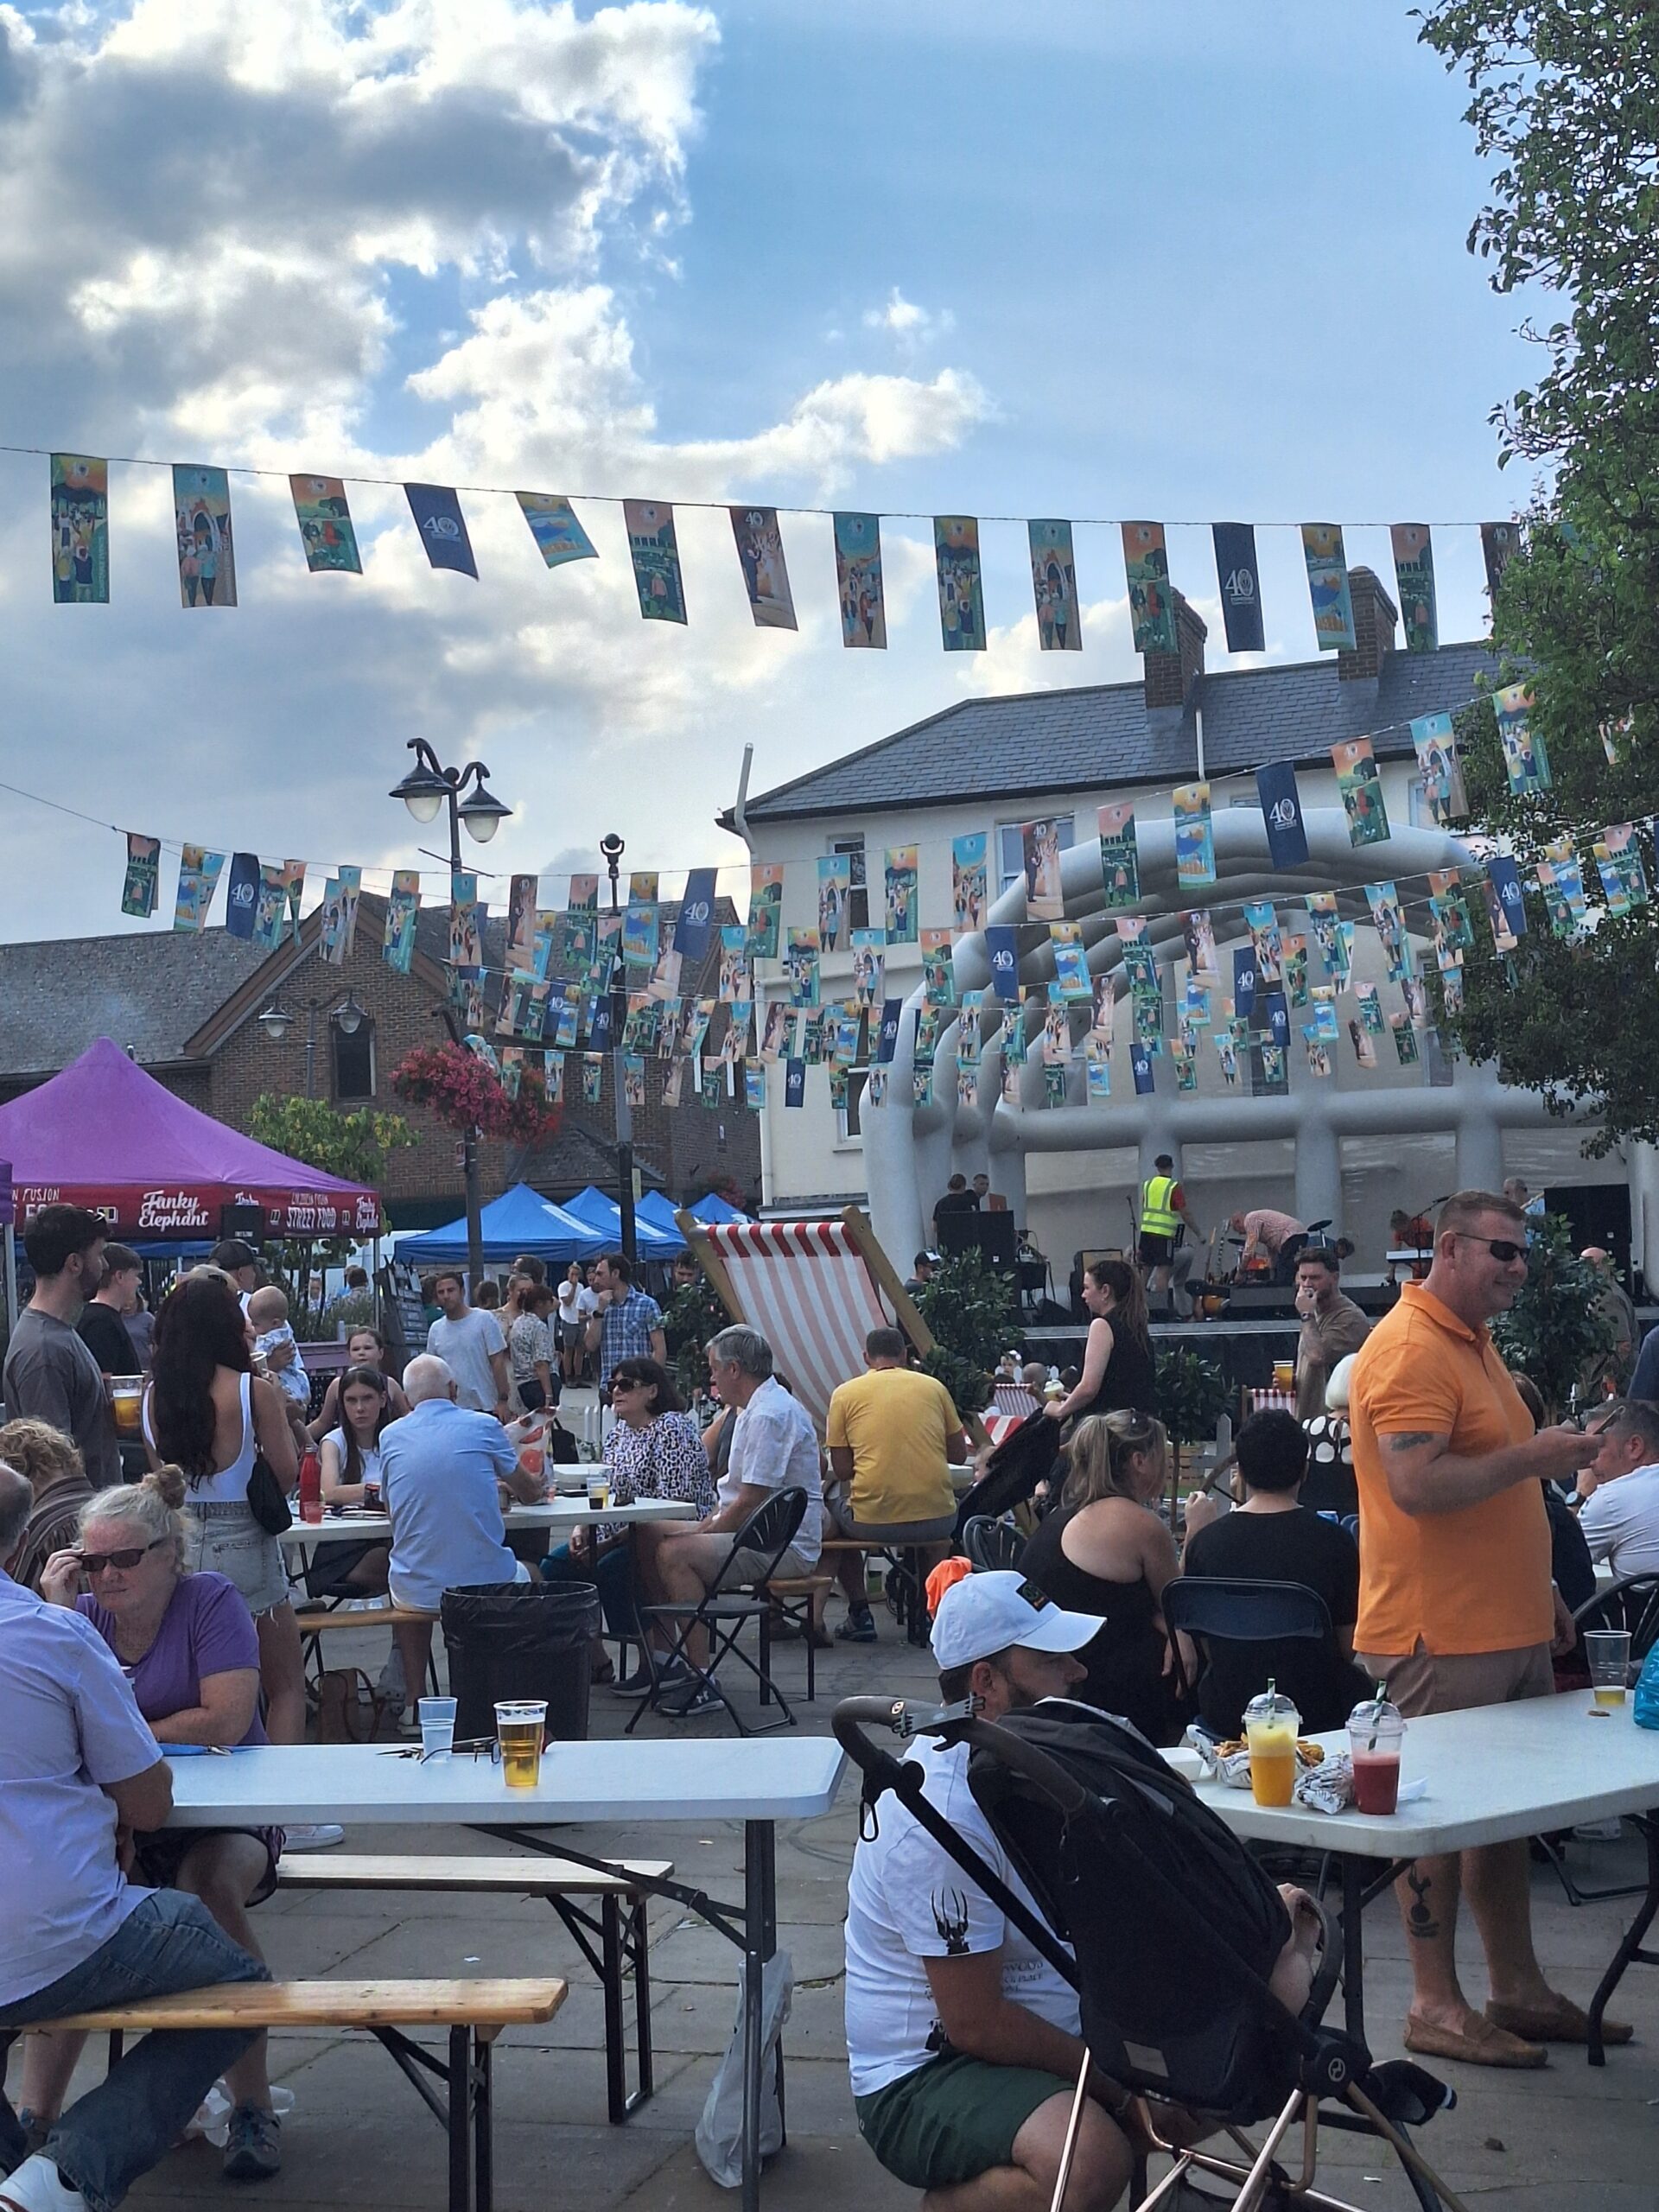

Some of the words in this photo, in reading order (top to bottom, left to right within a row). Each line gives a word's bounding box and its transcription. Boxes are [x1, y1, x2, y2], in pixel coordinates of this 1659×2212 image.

[423, 516, 460, 536] 40
[1224, 569, 1253, 596] 40
[1269, 798, 1295, 823] 40
[231, 883, 255, 904] 40
[1501, 881, 1520, 900] 40
[684, 901, 709, 922] 40
[993, 950, 1014, 967] 40
[1237, 970, 1254, 987] 40
[1134, 1059, 1148, 1072] 40
[22, 1187, 60, 1202] FUSION
[138, 1209, 209, 1232] Elephant
[286, 1206, 315, 1229] STREET
[316, 1207, 337, 1229] FOOD
